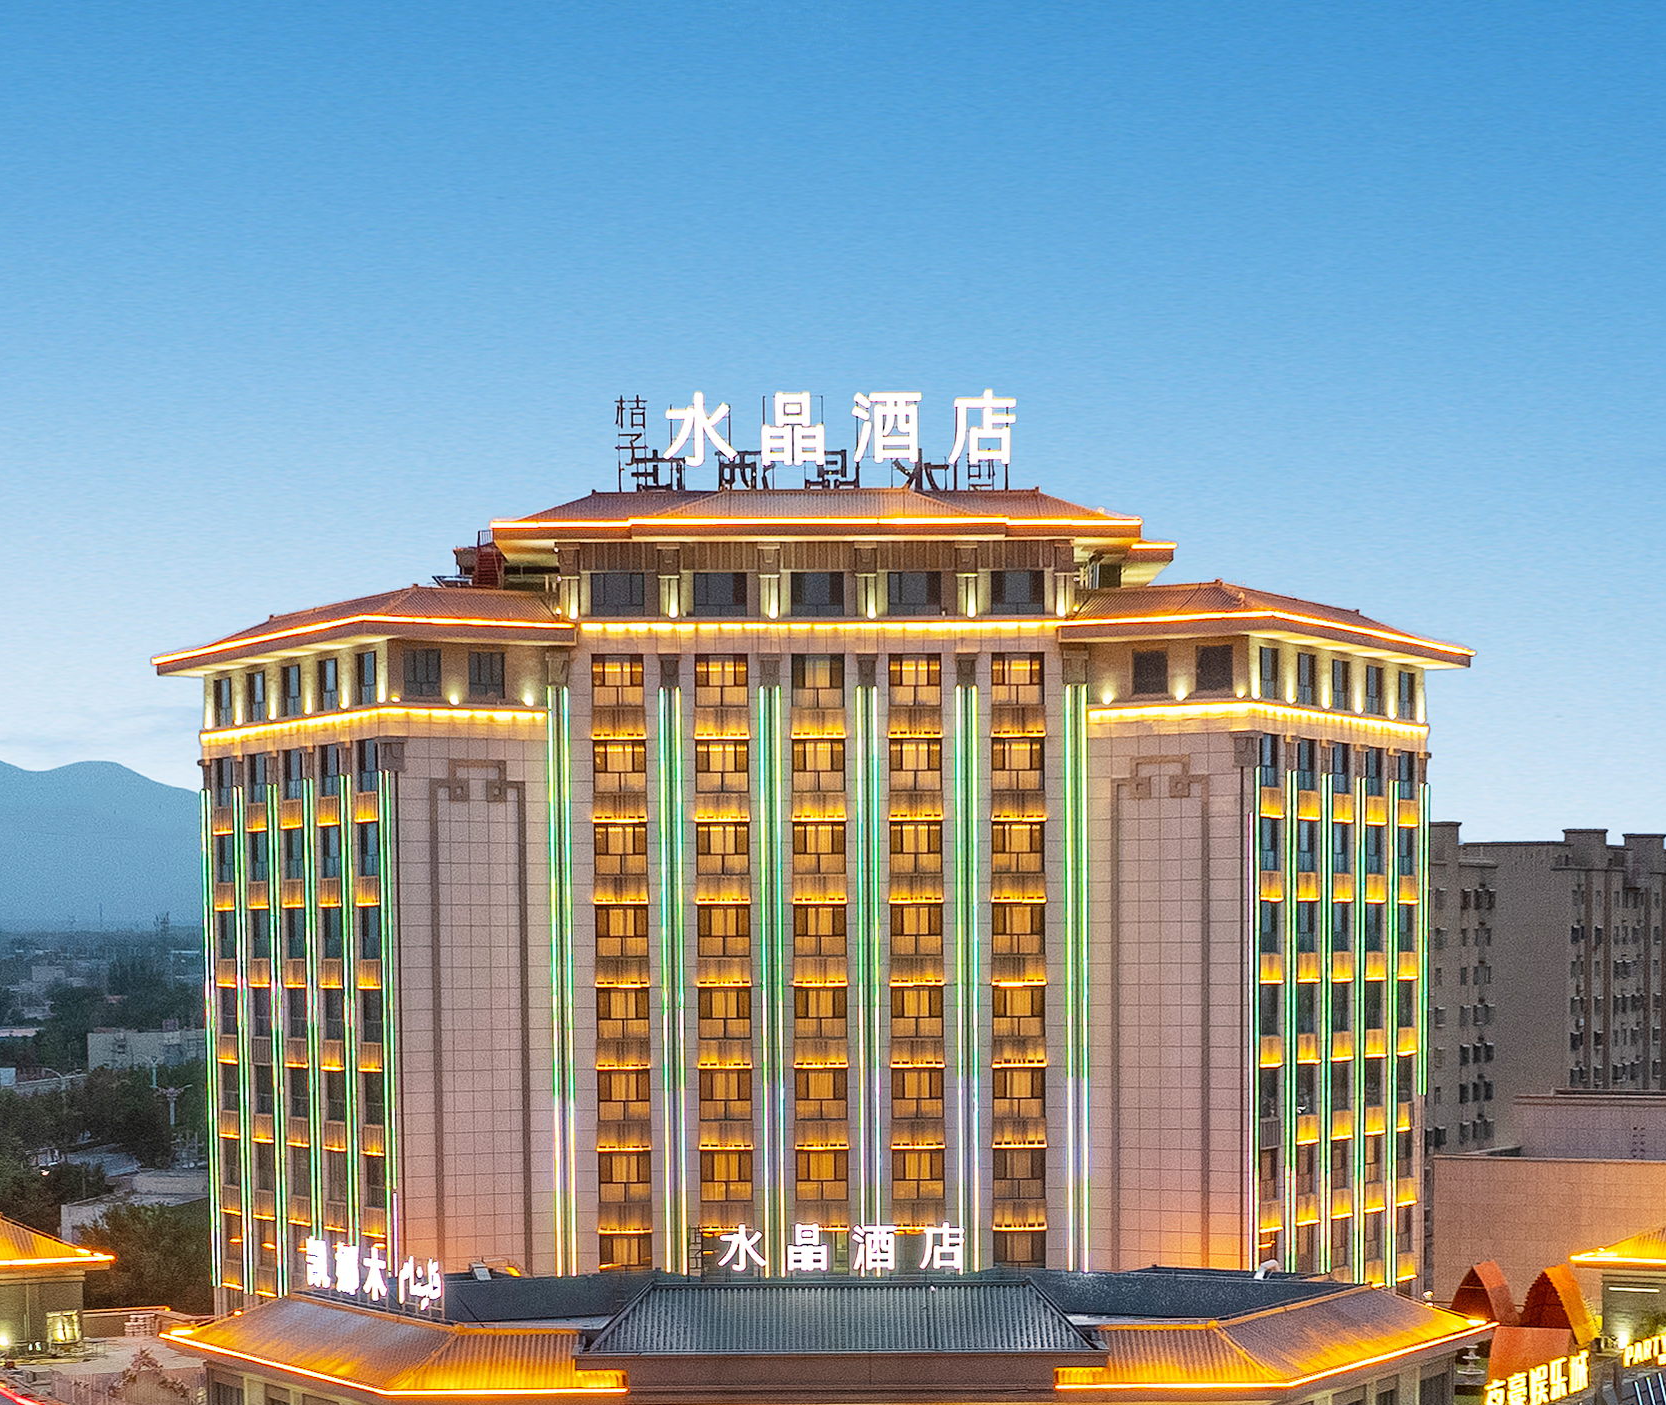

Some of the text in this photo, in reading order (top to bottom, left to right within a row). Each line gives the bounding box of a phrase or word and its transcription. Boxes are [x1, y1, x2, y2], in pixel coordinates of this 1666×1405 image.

[662, 388, 1017, 467] 水晶酒店
[717, 1221, 966, 1272] 水晶酒店
